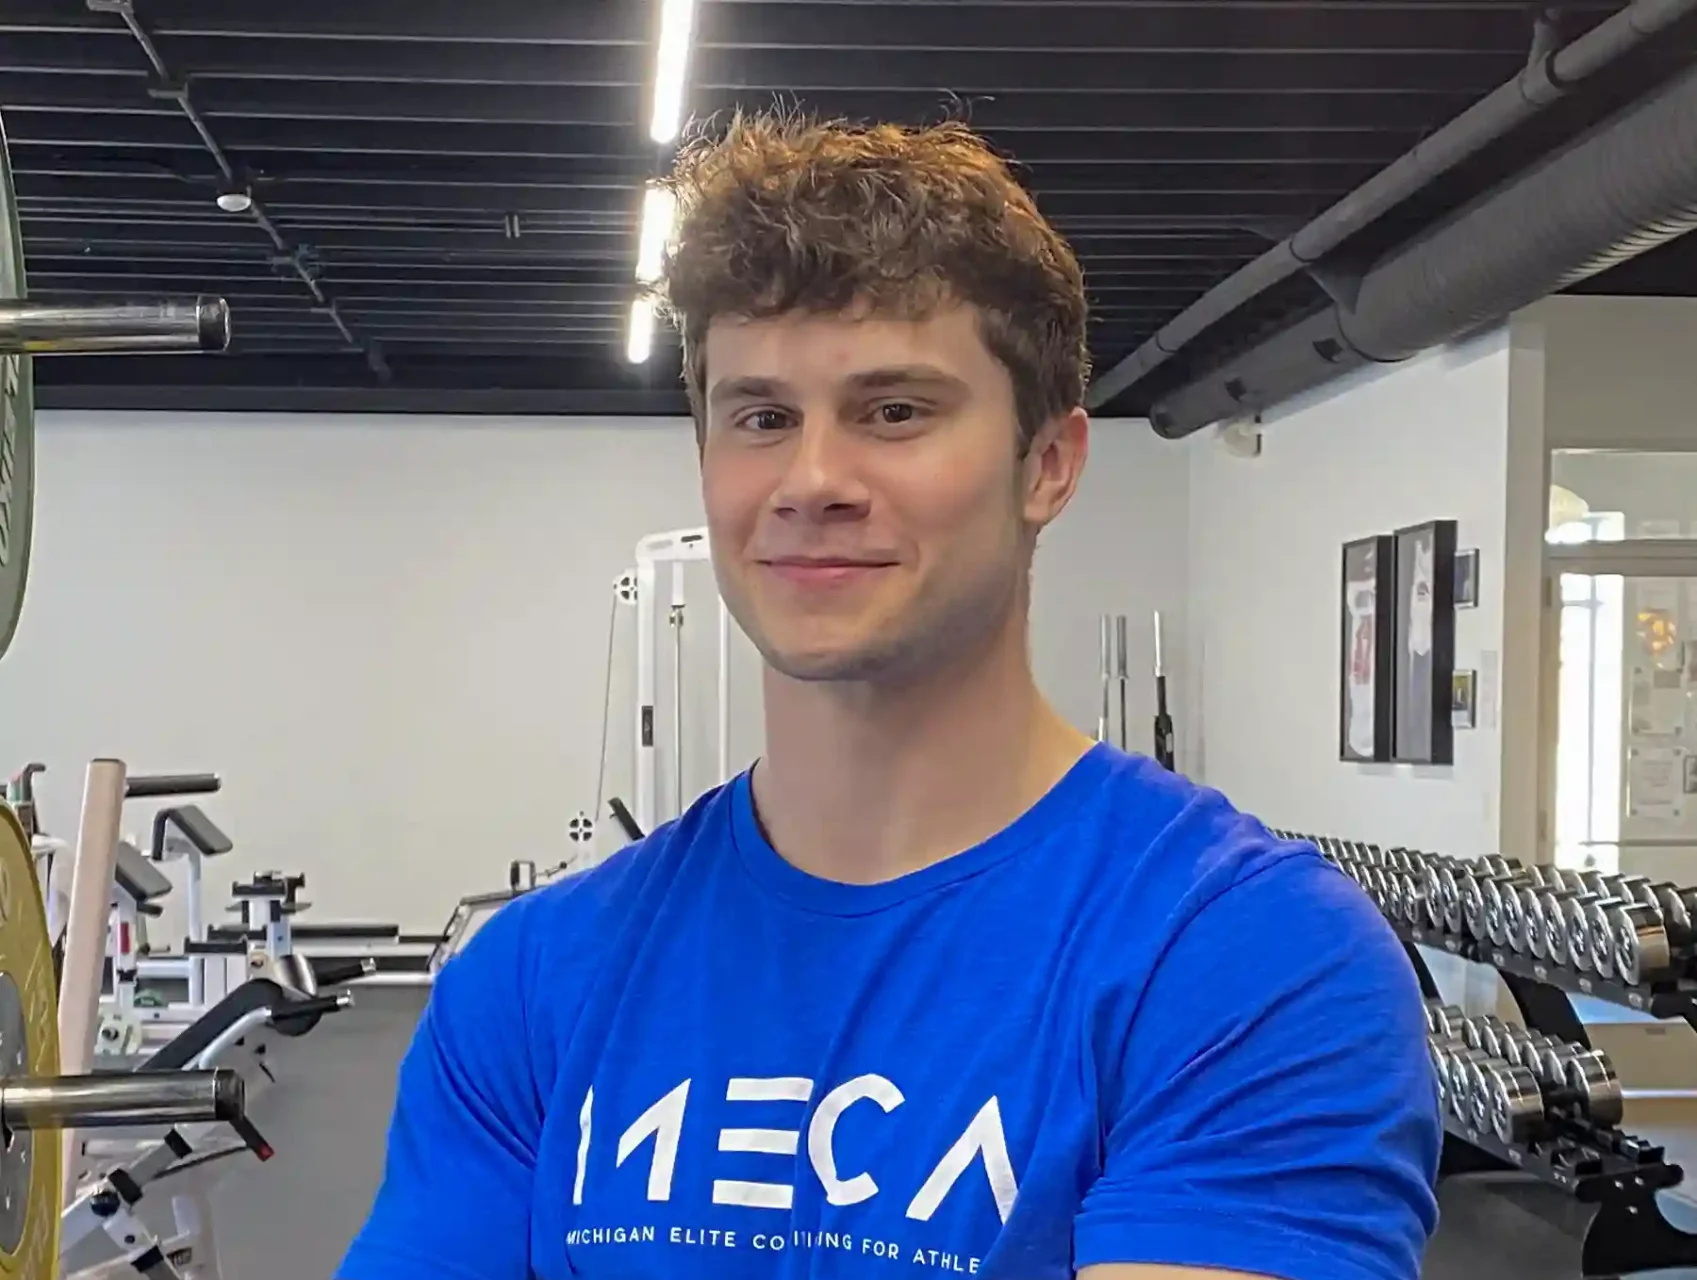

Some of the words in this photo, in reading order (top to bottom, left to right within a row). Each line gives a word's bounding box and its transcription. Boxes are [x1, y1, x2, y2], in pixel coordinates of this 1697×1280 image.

[573, 1073, 1019, 1225] MECA
[566, 1226, 655, 1245] MICHIGAN
[669, 1227, 736, 1247] ELITE
[862, 1238, 899, 1260] FOR
